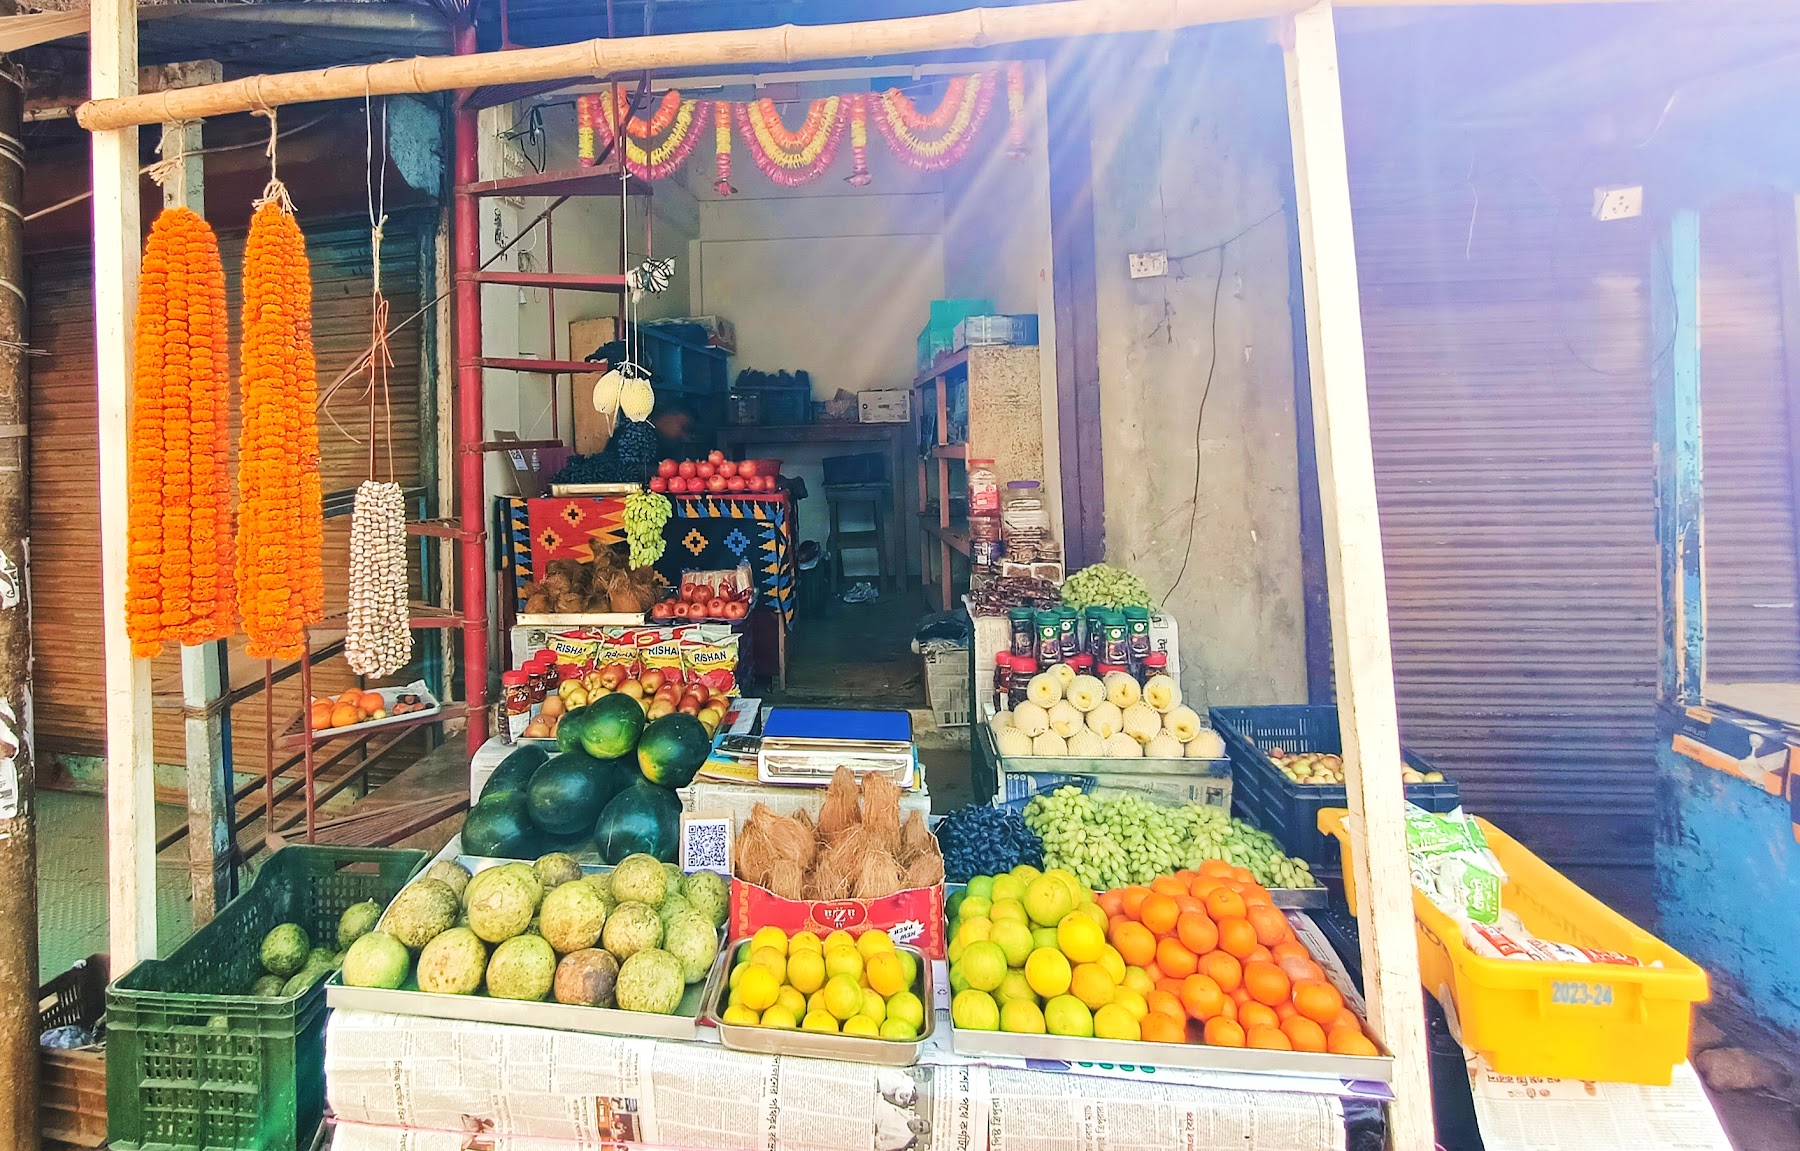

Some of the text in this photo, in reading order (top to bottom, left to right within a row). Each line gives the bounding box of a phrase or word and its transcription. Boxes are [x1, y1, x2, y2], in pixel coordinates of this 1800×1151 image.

[556, 642, 587, 655] RISHA
[648, 646, 680, 656] RISHA
[694, 650, 727, 662] RISHAN
[894, 924, 913, 935] PACK
[899, 931, 916, 940] NEW
[1552, 982, 1612, 1006] 2023-24
